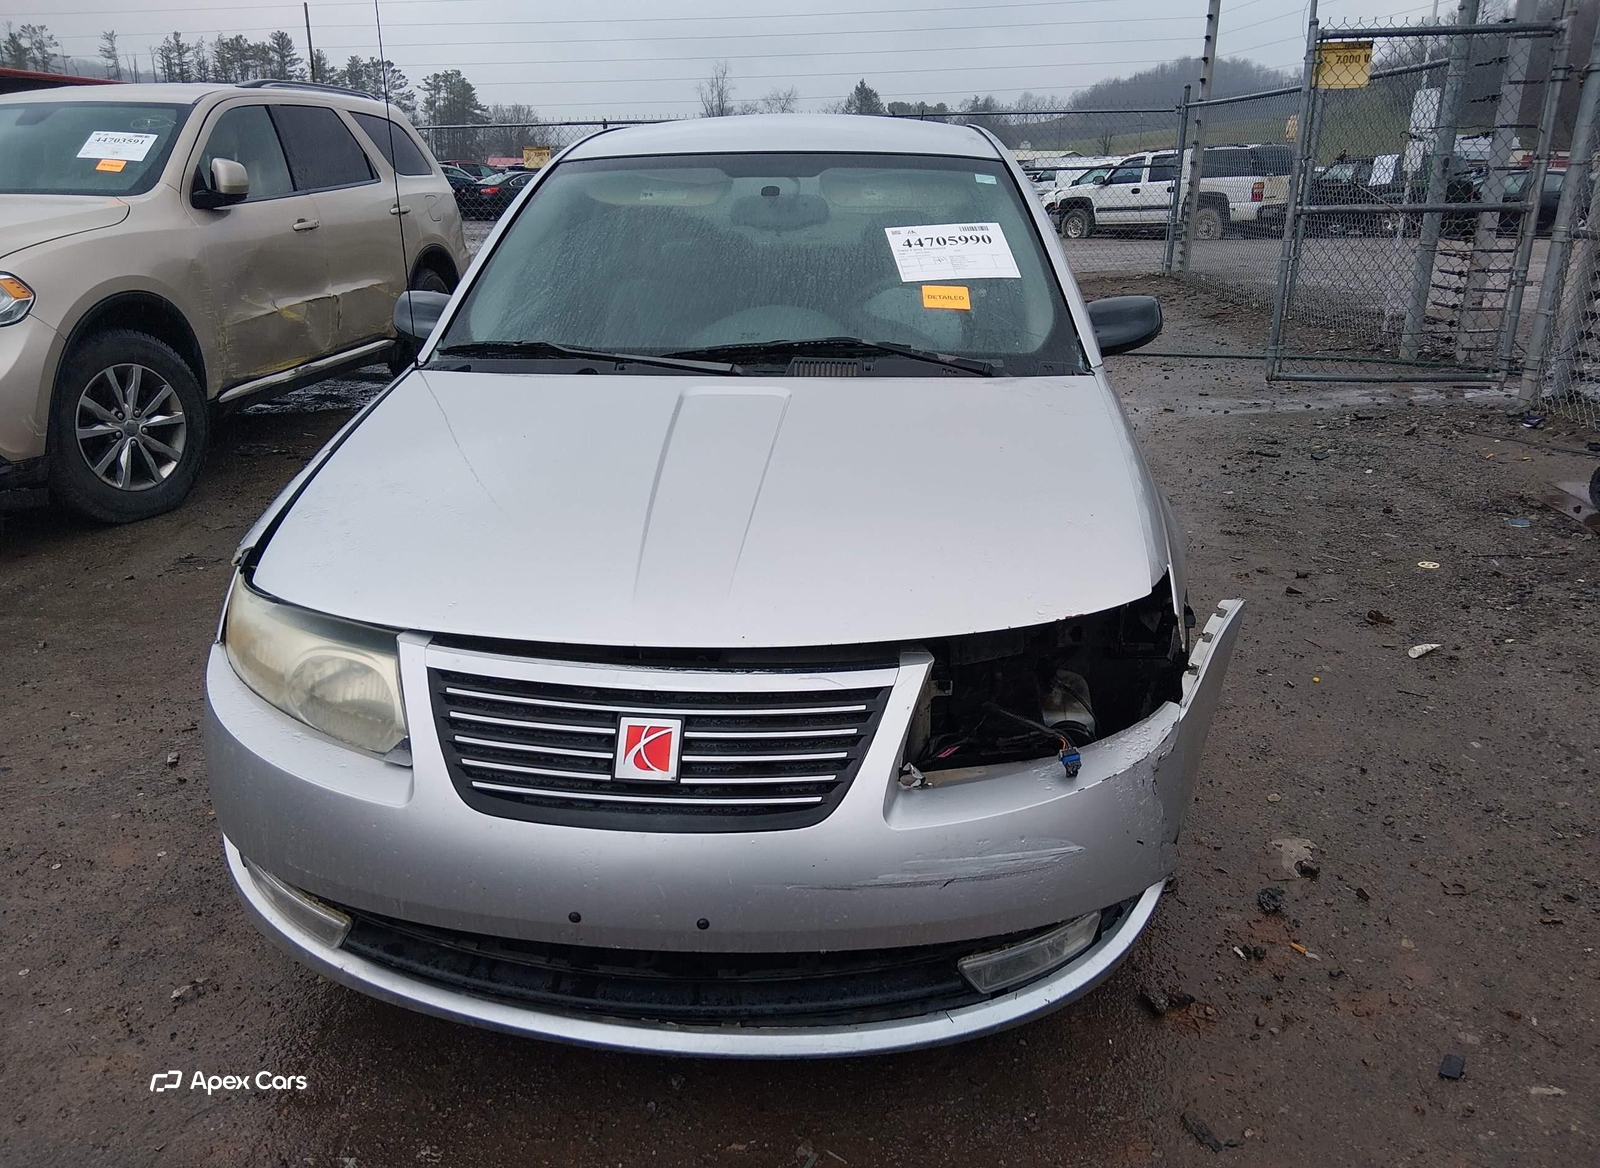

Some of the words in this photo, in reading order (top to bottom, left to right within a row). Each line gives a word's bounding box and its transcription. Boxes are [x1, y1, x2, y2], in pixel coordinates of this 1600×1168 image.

[1336, 54, 1361, 64] 7,000
[94, 137, 145, 145] 44703591
[902, 234, 992, 248] 44705990
